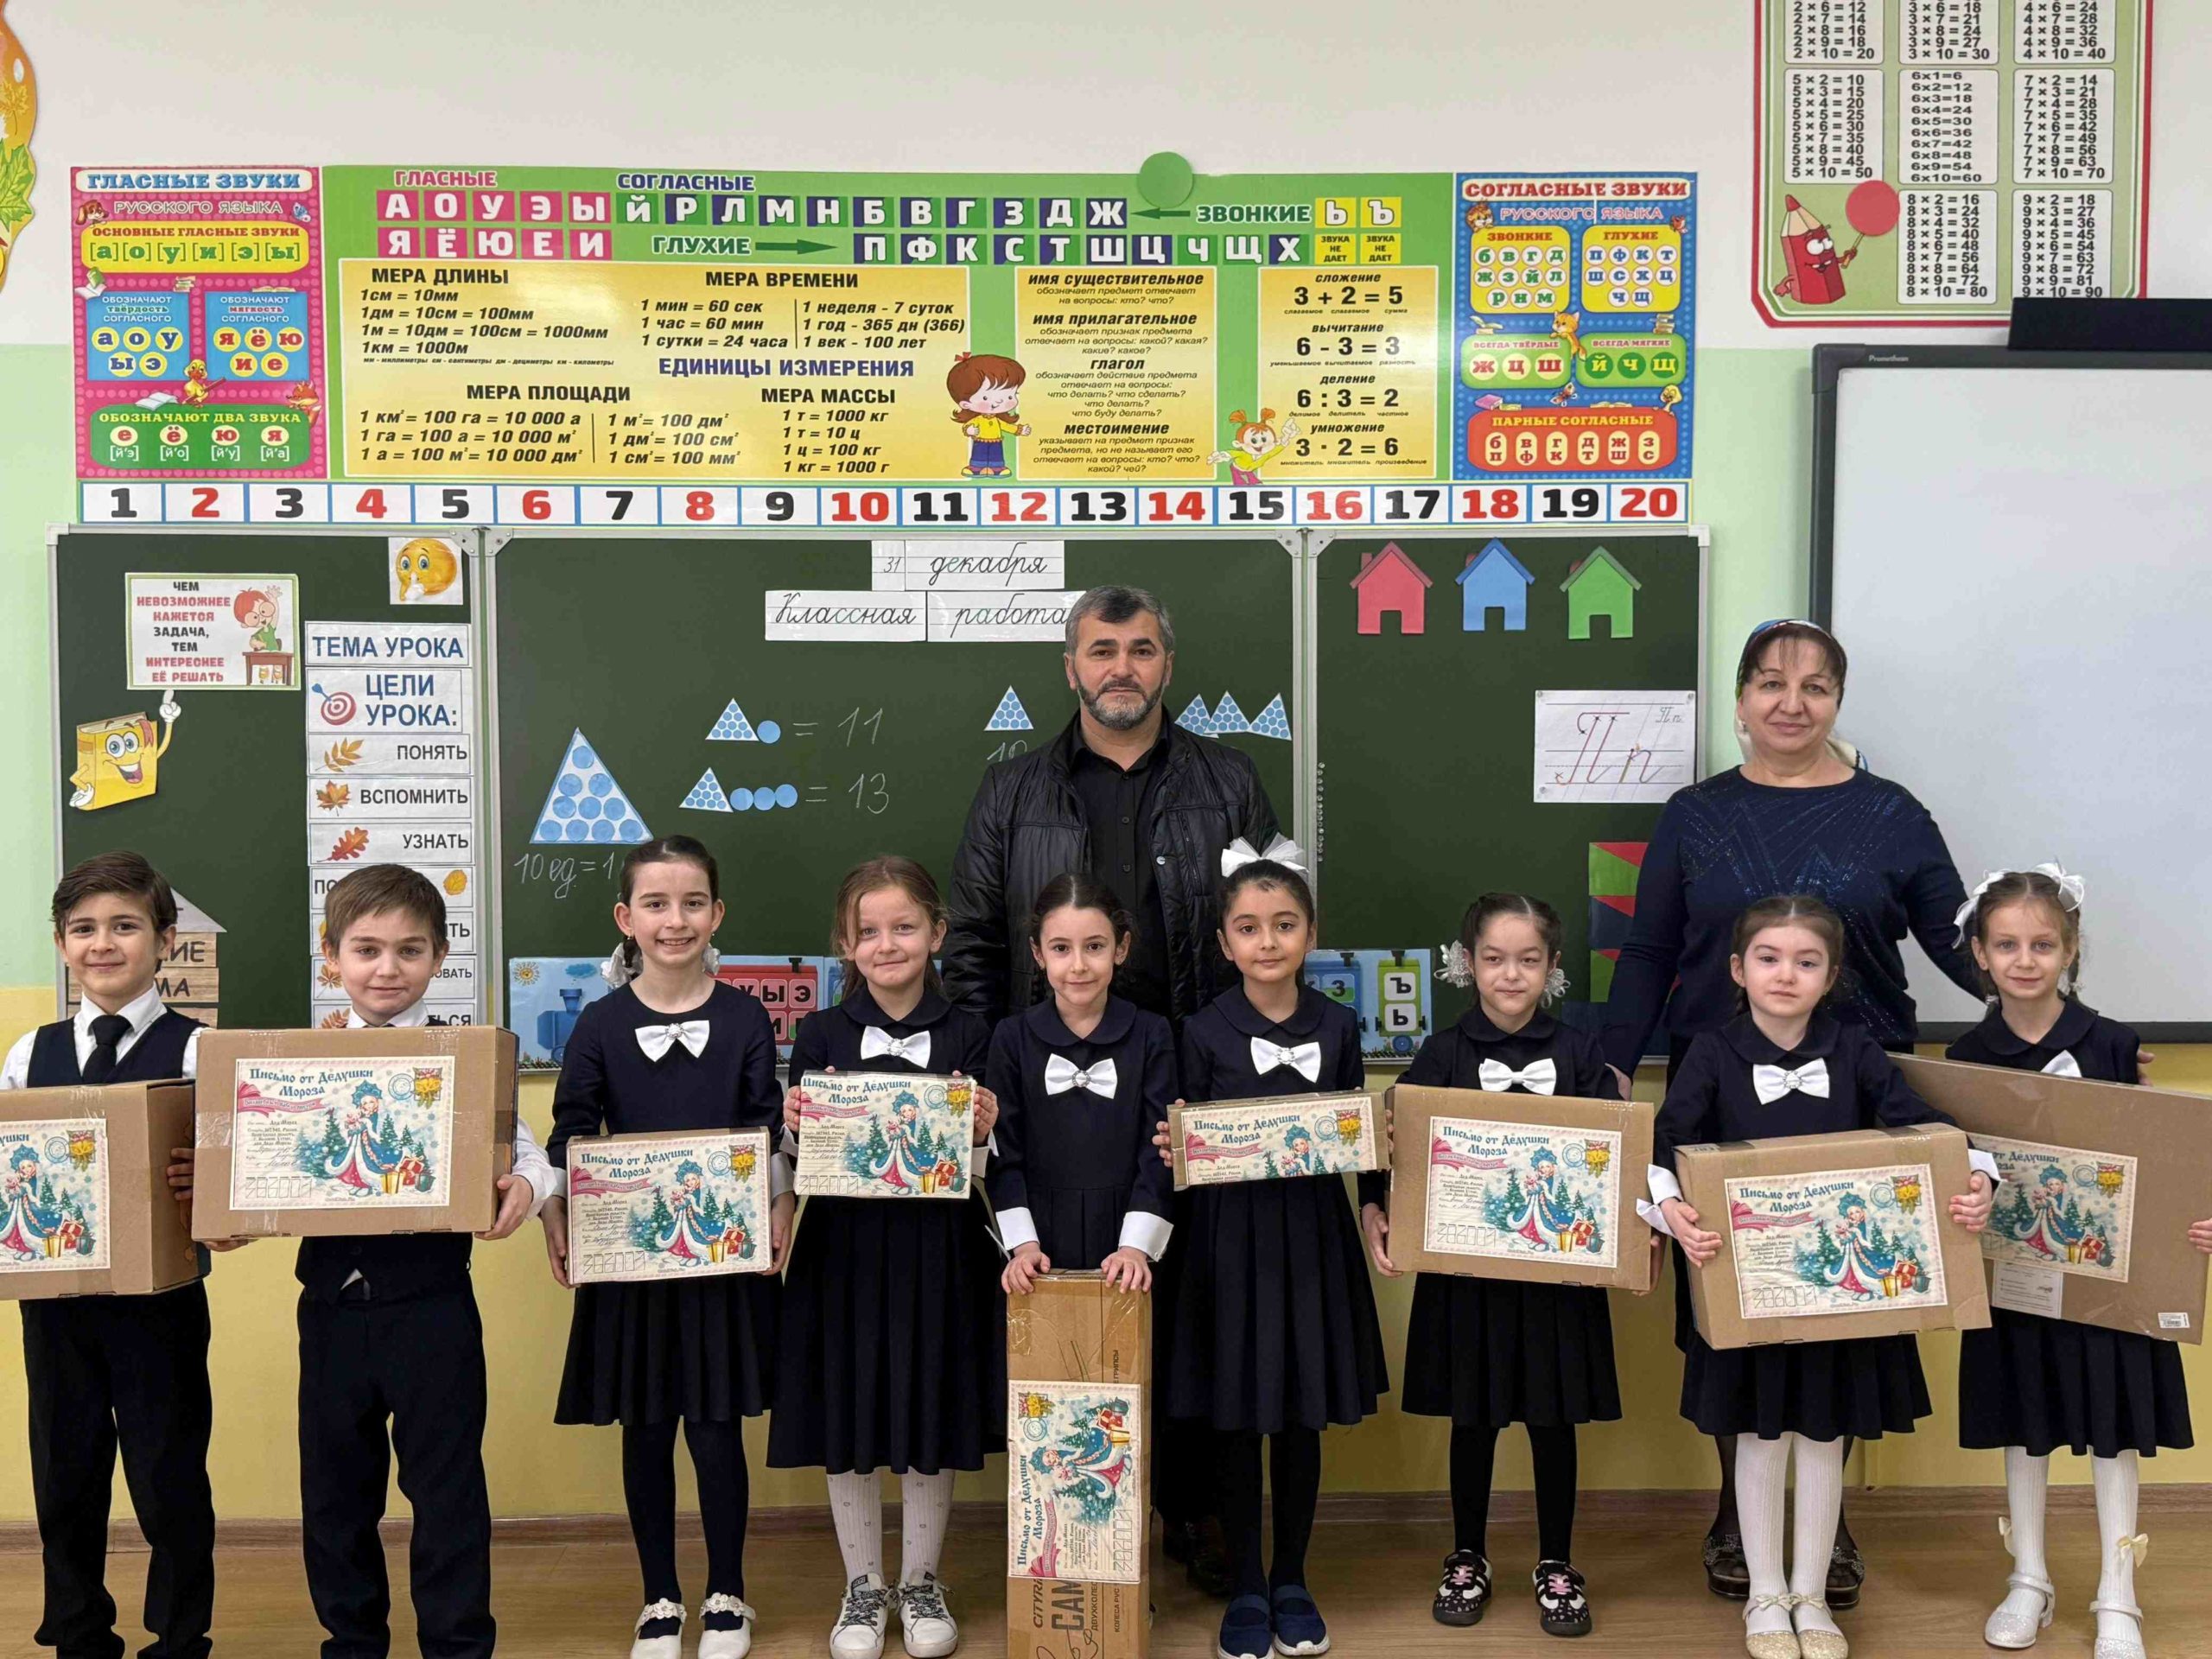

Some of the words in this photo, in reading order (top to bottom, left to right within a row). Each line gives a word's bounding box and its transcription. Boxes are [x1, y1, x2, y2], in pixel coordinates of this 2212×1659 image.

[87, 174, 210, 188] ГЛАСНЫЕ
[216, 174, 300, 188] ЗВУКИ
[396, 171, 497, 188] ГЛАСНЫЕ
[618, 174, 755, 192] СОГЛАСНЫЕ
[1465, 182, 1606, 197] СОГЛАСНЫЕ
[1611, 182, 1687, 196] ЗВУКИ
[114, 200, 213, 213] РУССКОГО
[219, 200, 283, 213] ЯЗЫКА
[1500, 207, 1595, 220] РУССКОГО
[1601, 207, 1663, 219] ЯЗЫКА
[1198, 206, 1311, 223] ЗВОНКИЕ
[1487, 232, 1553, 241] ЗВОНКИЕ
[1604, 232, 1658, 240] ГЛУХИЕ
[652, 236, 751, 256] ГЛУХИЕ
[372, 269, 426, 283] МЕРА
[434, 269, 508, 285] ДЛИНЫ
[706, 272, 759, 286] МЕРА
[766, 273, 858, 288] ВРЕМЕНИ
[1029, 275, 1058, 284] имя
[1065, 274, 1204, 288] существительное
[1316, 274, 1381, 283] сложение
[361, 289, 391, 301] 1см
[415, 289, 458, 302] 10мм
[1098, 288, 1142, 296] предмет
[641, 299, 649, 311] 1
[656, 302, 688, 312] мин
[709, 300, 728, 312] 60
[734, 302, 763, 313] сек
[803, 301, 811, 313] 1
[817, 302, 876, 315] неделя
[894, 302, 902, 314] 7
[910, 302, 953, 315] суток
[1033, 315, 1063, 324] имя
[1069, 315, 1197, 327] прилагательное
[1312, 324, 1383, 333] вычитание
[659, 359, 771, 377] ЕДИНИЦЫ
[779, 360, 914, 376] ИЗМЕРЕНИЯ
[1090, 359, 1145, 370] глагол
[1319, 375, 1376, 385] деление
[467, 385, 520, 400] МЕРА
[529, 385, 631, 402] ПЛОЩАДИ
[761, 389, 814, 403] МЕРА
[821, 389, 895, 403] МАССЫ
[99, 413, 209, 423] ОБОЗНАЧАЮТ
[214, 413, 245, 423] ДВА
[250, 413, 301, 423] ЗВУКА
[1492, 416, 1556, 426] ПАРНЫЕ
[1560, 416, 1654, 426] СОГЛАСНЫЕ
[1065, 424, 1169, 434] местоимение
[1311, 424, 1384, 435] умножение
[913, 493, 969, 522] 11
[991, 492, 1047, 522] 12
[1071, 492, 1127, 522] 13
[1229, 491, 1285, 520] 15
[1384, 490, 1441, 519] 17
[1542, 488, 1599, 518] 19
[1619, 488, 1677, 518] 20
[883, 558, 901, 573] 31
[929, 543, 1048, 586] декабря
[174, 582, 199, 591] ЧЕМ
[137, 597, 231, 607] НЕВОЗМОЖНЕЕ
[153, 612, 214, 621] КАЖЕТСЯ
[775, 593, 917, 625] Классная
[950, 593, 1067, 638] работа
[154, 627, 209, 638] ЗАДАЧА,
[171, 643, 198, 652] ТЕМ
[313, 637, 380, 658] ТЕМА
[385, 638, 464, 659] УРОКА
[146, 658, 224, 667] ИНТЕРЕСНЕЕ
[152, 672, 166, 682] ЕЁ
[172, 672, 224, 682] РЕШАТЬ
[366, 674, 435, 700] ЦЕЛИ
[365, 706, 457, 727] УРОКА:
[837, 708, 883, 747] 11
[397, 745, 467, 761] ПОНЯТЬ
[360, 789, 468, 804] ВСПОМНИТЬ
[849, 773, 889, 814] 13
[403, 834, 468, 849] УЗНАТЬ
[514, 854, 543, 883] 10
[250, 1069, 296, 1083] Письмо
[300, 1074, 315, 1084] от
[319, 1070, 373, 1084] Дедушки
[279, 1086, 325, 1099] Мороза
[803, 1078, 842, 1090] Письмо
[862, 1081, 911, 1093] Дедушки
[829, 1094, 868, 1105] Мороза
[1194, 1121, 1234, 1131] Письмо
[1254, 1115, 1300, 1131] Дедушки
[1221, 1133, 1261, 1145] Мороза
[1443, 1127, 1482, 1142] Письмо
[1502, 1135, 1549, 1147] Дедушки
[582, 1154, 623, 1166] Письмо
[644, 1149, 693, 1165] Дедушки
[1468, 1145, 1508, 1158] Мороза
[609, 1167, 651, 1179] Мороза
[1740, 1188, 1783, 1198] Письмо
[1787, 1191, 1800, 1199] от
[1804, 1182, 1854, 1198] Дедушки
[1770, 1201, 1812, 1214] Мороза
[1024, 1508, 1031, 1522] от
[1033, 1497, 1045, 1540] Мороза
[1018, 1525, 1031, 1566] Письмо
